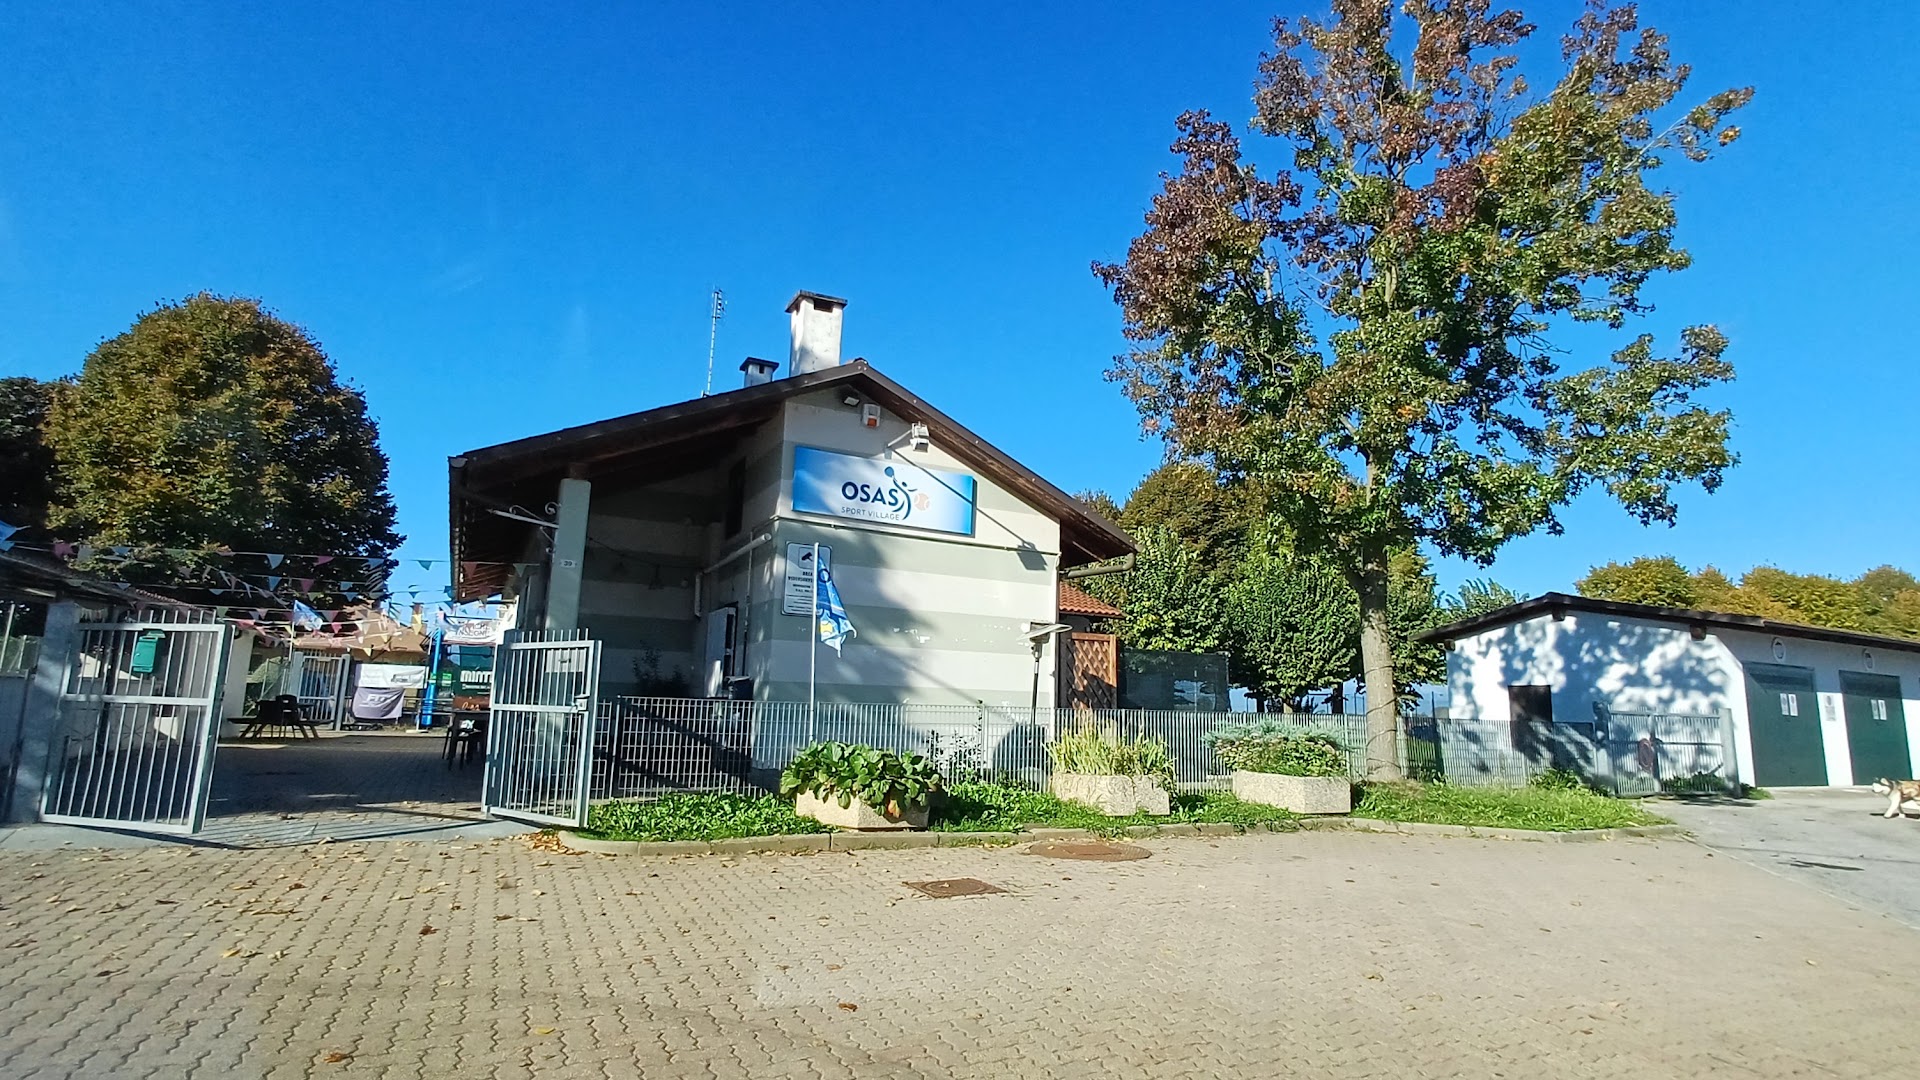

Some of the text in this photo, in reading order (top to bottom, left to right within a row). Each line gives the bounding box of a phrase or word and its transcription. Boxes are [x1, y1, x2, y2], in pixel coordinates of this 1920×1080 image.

[841, 481, 899, 507] OSAS
[841, 506, 900, 521] SPORT VILLAGE
